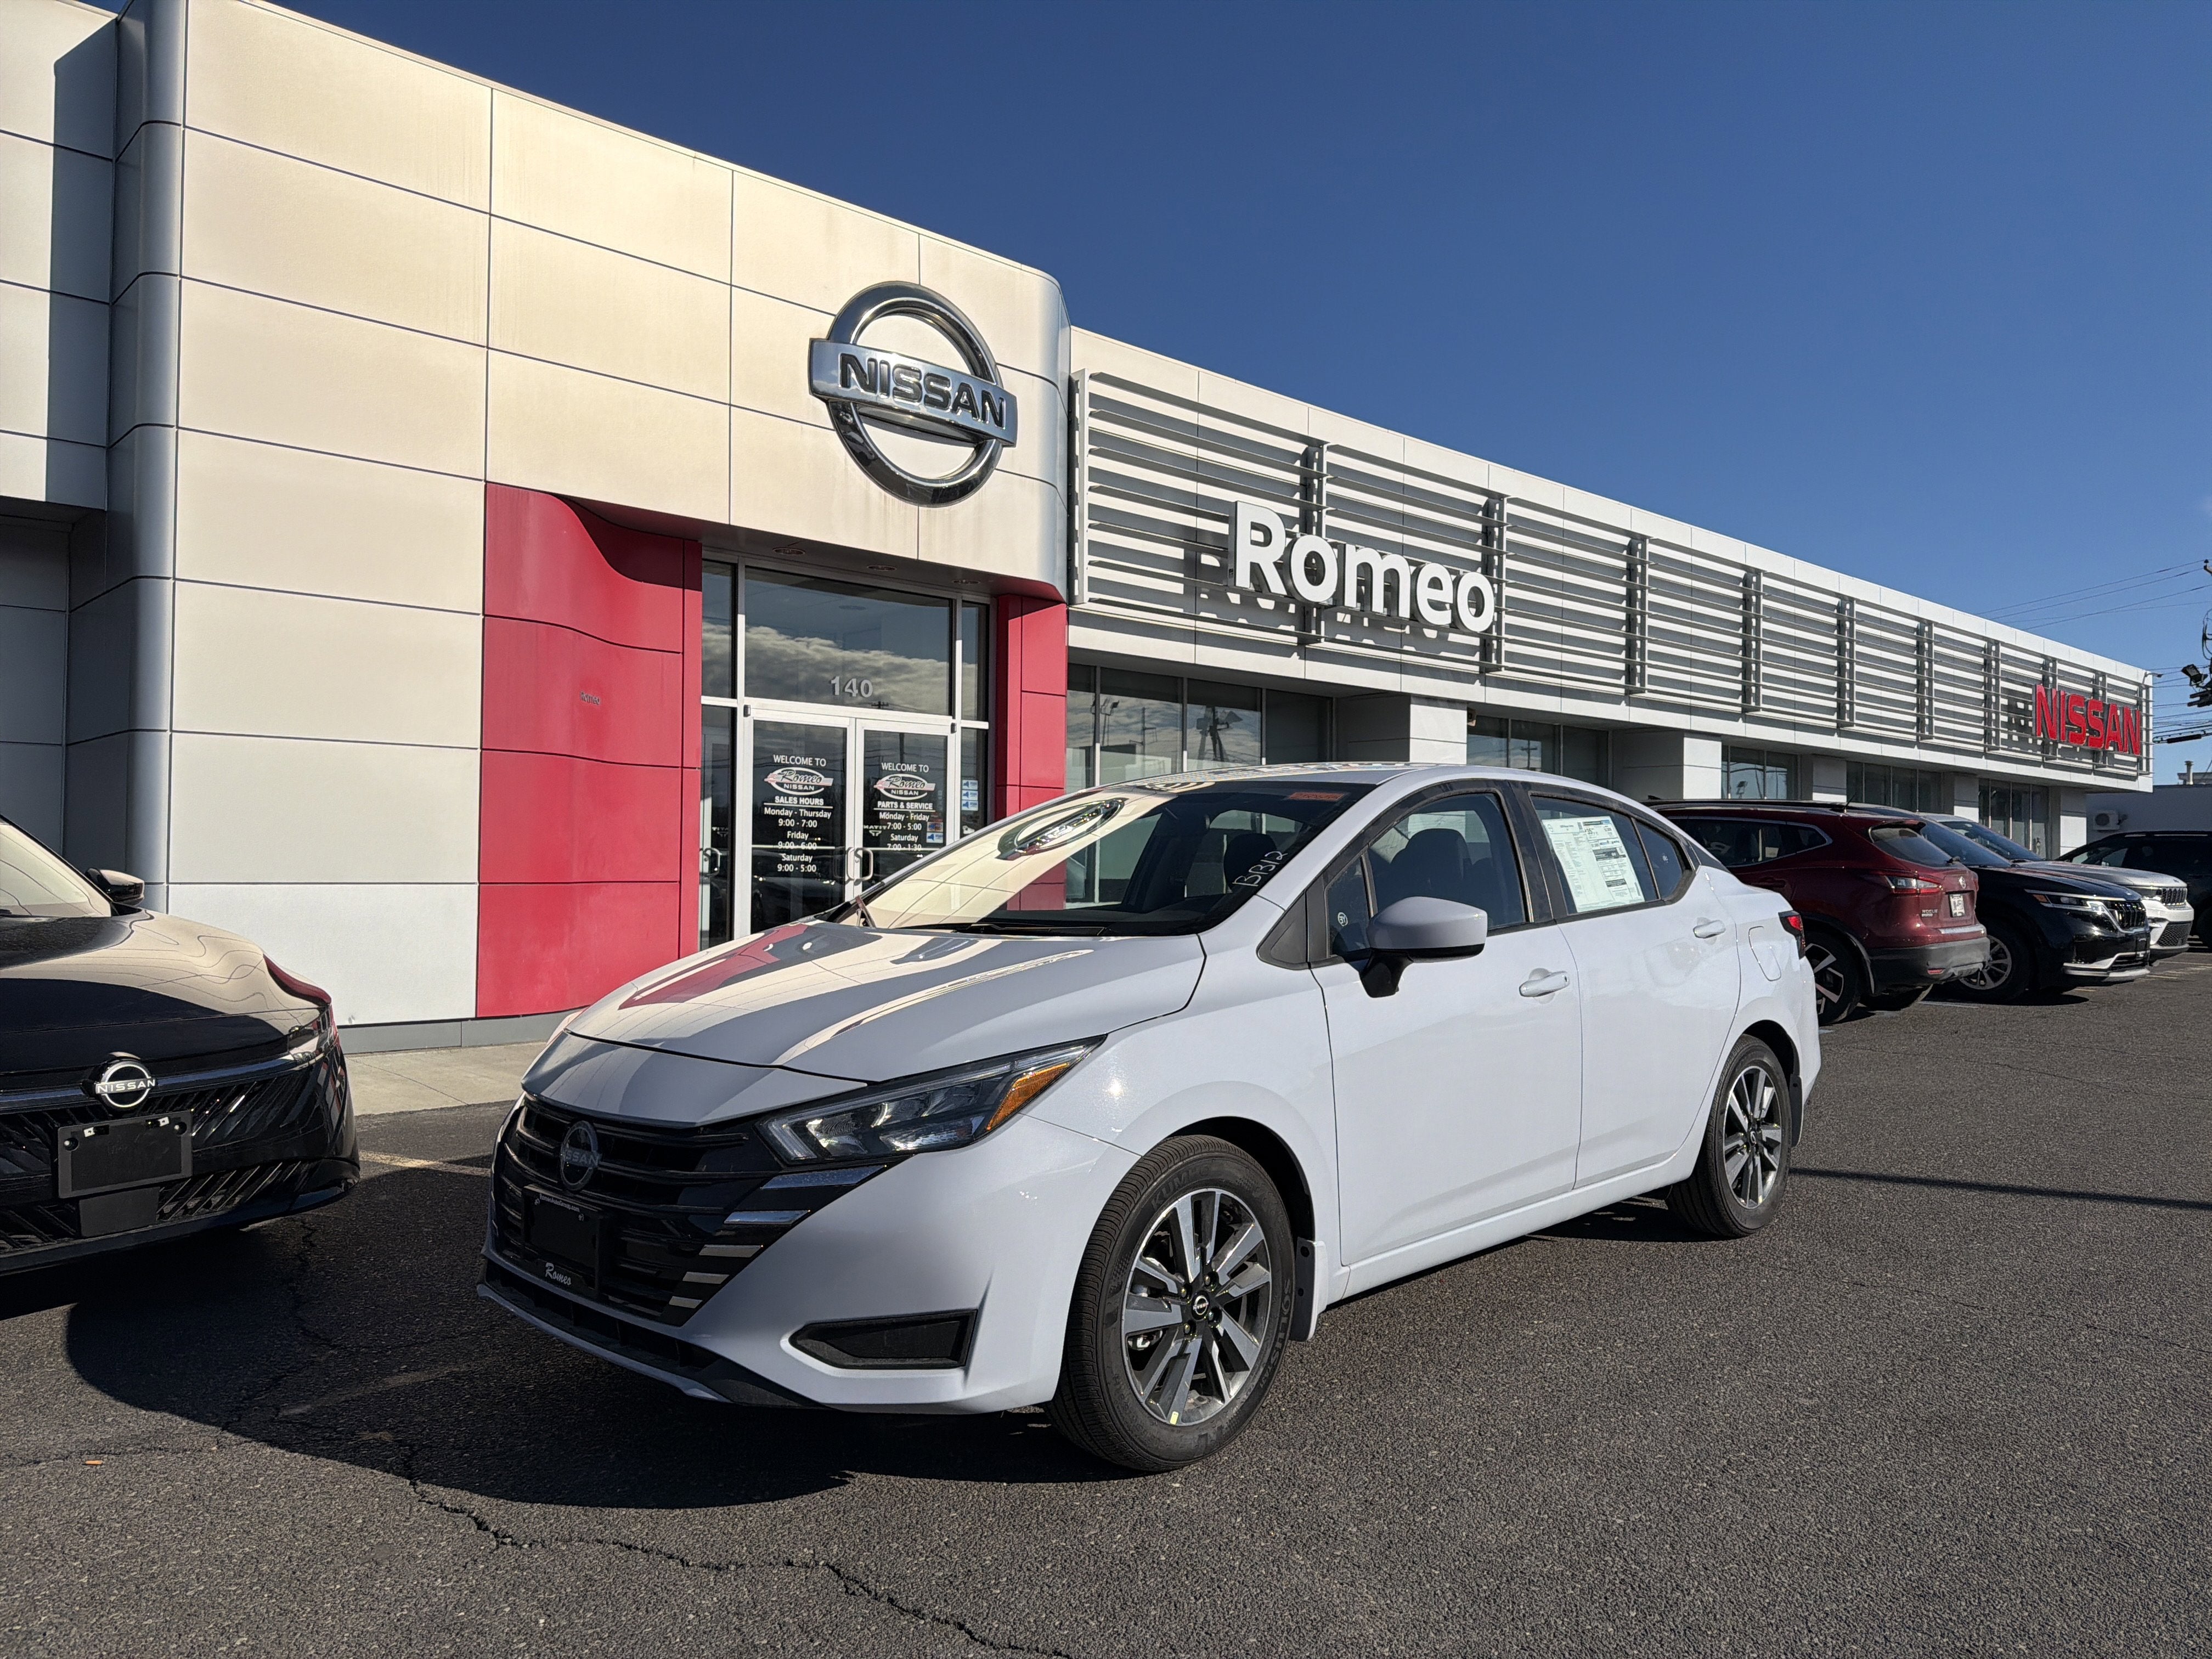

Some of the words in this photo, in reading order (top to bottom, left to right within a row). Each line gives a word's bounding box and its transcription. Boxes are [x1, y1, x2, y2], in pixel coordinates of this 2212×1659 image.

[838, 352, 1006, 430] NISSAN
[1235, 500, 1495, 633] Romeo
[830, 675, 873, 698] 140
[2035, 684, 2141, 756] NISSAN
[773, 754, 813, 766] WELCOME
[815, 758, 826, 767] TO
[881, 762, 917, 772] WELCOME
[918, 764, 929, 773] TO
[777, 769, 822, 783] Romeo
[885, 775, 926, 788] Romeo
[775, 795, 798, 804] SALES
[799, 797, 824, 805] HOURS
[877, 800, 898, 809] PARTS
[906, 802, 933, 810] SERVICE
[764, 807, 793, 817] Monday
[799, 809, 832, 819] Thursday
[879, 811, 905, 821] Monday
[910, 812, 930, 822] Friday
[778, 818, 795, 827] 9:00
[801, 819, 817, 828] 7:00
[887, 822, 902, 830] 7:00
[787, 831, 809, 840] Friday
[890, 833, 919, 843] Saturday
[778, 841, 795, 849] 9:00
[781, 853, 813, 863] Saturday
[777, 864, 794, 872] 9:00
[800, 864, 817, 872] 5:00
[97, 1079, 155, 1094] NISSAN
[545, 1262, 572, 1286] Romeo
